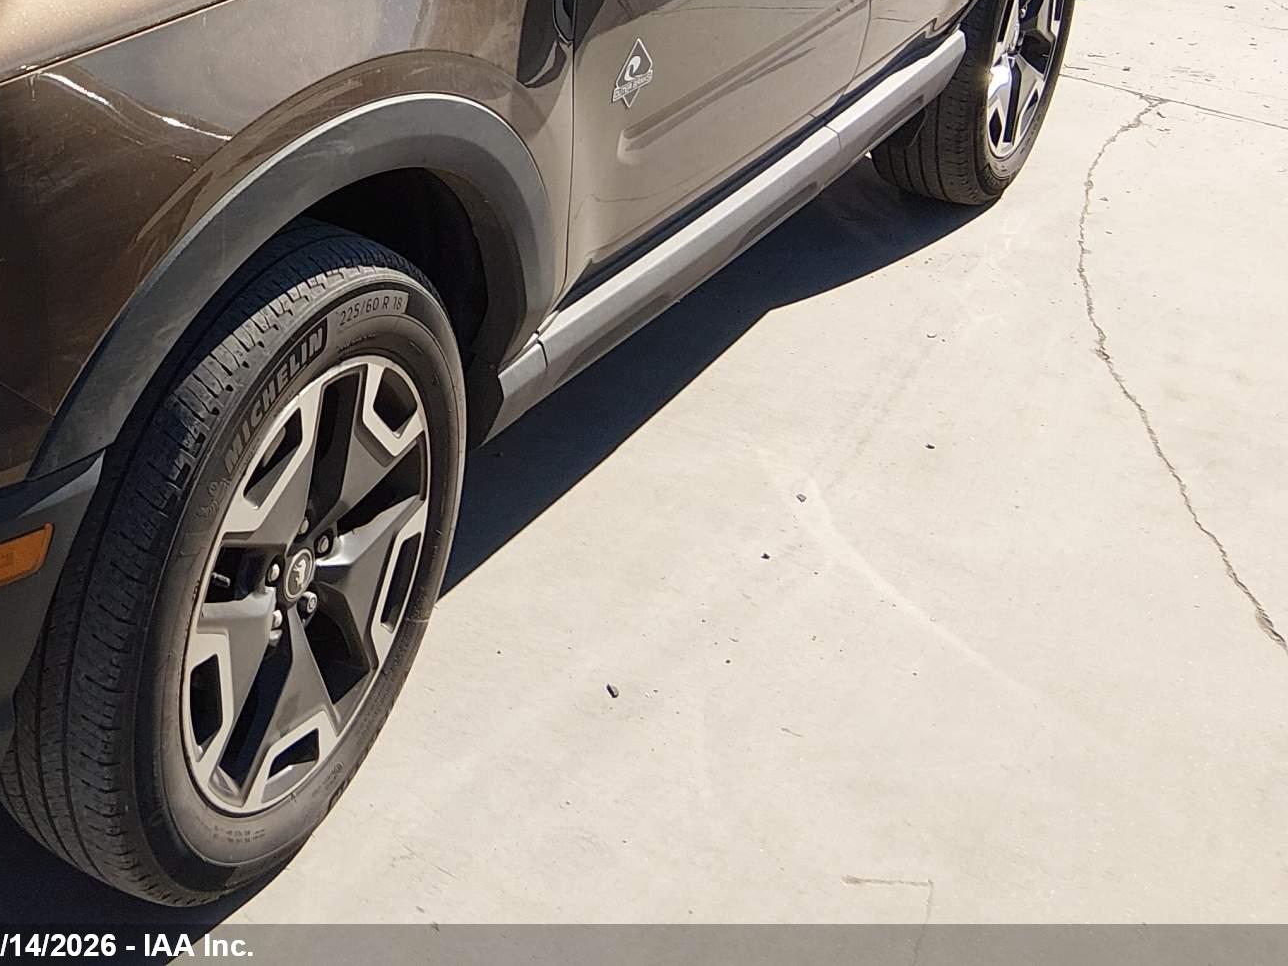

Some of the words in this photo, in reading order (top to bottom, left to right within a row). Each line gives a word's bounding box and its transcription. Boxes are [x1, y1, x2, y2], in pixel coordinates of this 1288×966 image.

[339, 296, 380, 326] 225/60
[382, 296, 390, 310] R
[392, 295, 403, 311] 18
[224, 322, 325, 474] MICHELIN
